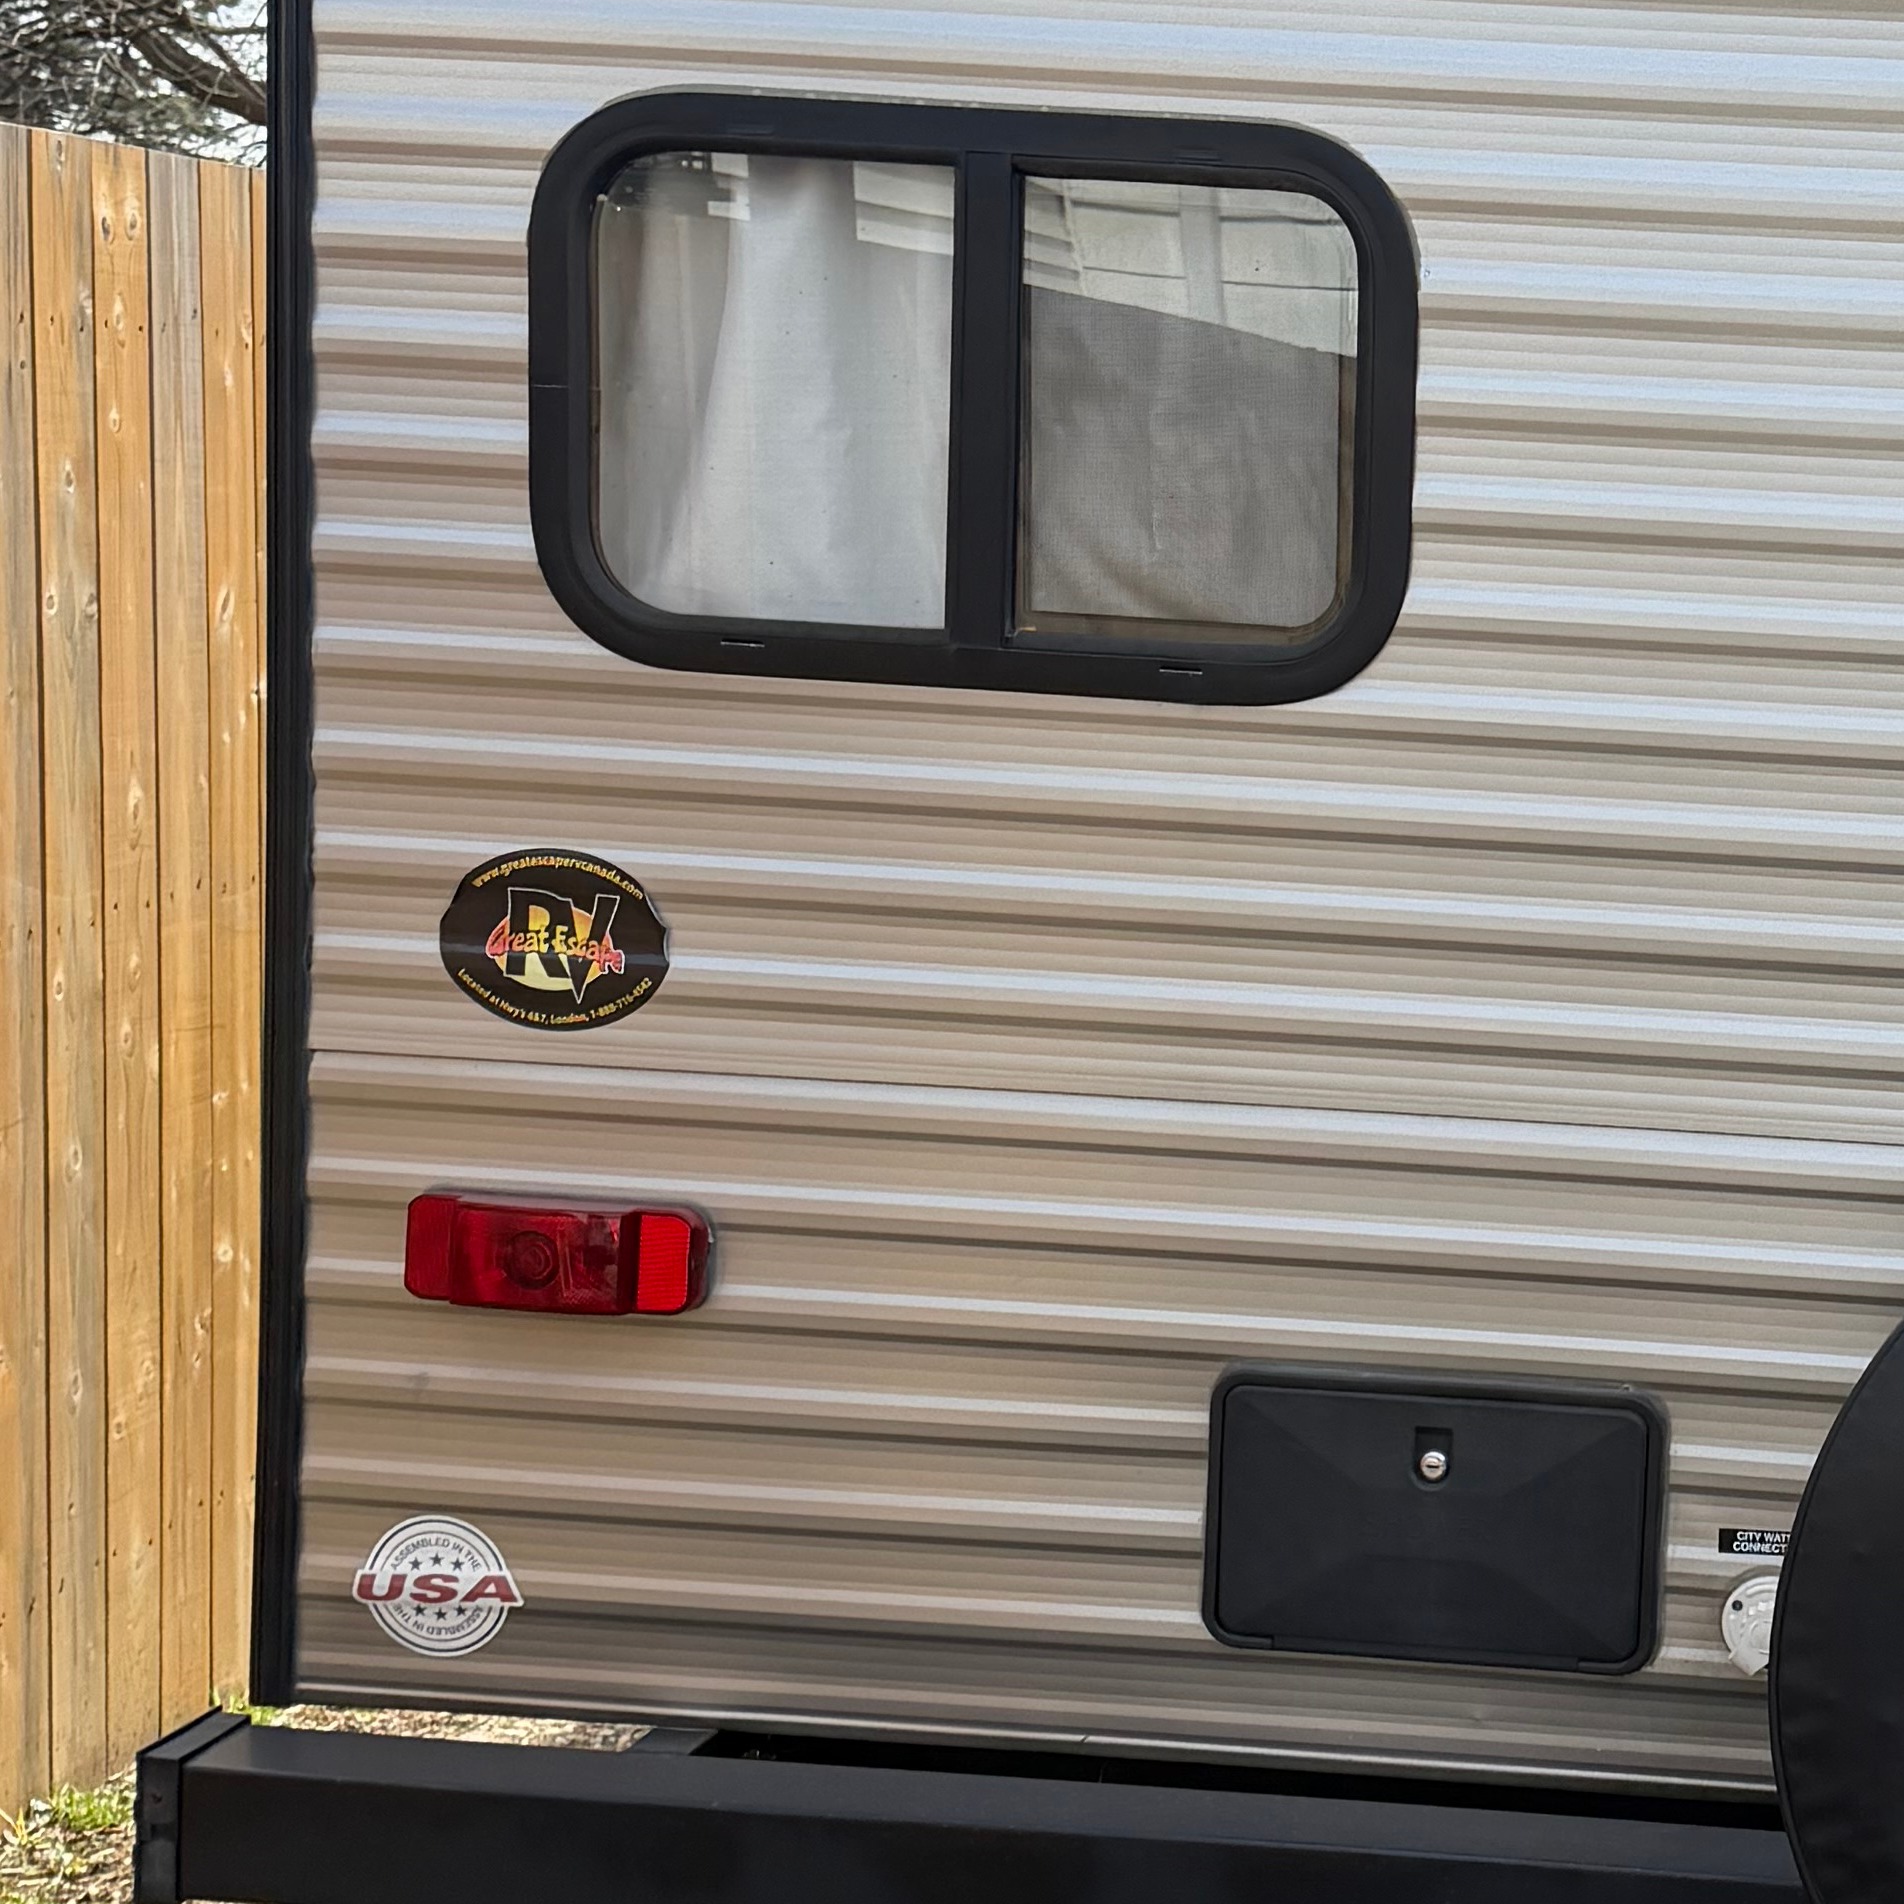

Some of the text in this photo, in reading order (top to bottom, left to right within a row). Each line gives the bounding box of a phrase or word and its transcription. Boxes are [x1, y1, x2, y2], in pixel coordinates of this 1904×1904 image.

[471, 855, 644, 901] www.greatescapervcanada.com
[485, 923, 626, 975] Great Escape
[503, 886, 620, 1004] RV
[391, 1536, 482, 1572] ASSEMBLED IN THE
[1733, 1541, 1789, 1553] CONNECT
[1736, 1532, 1791, 1542] CITY WAT
[356, 1573, 519, 1604] USA
